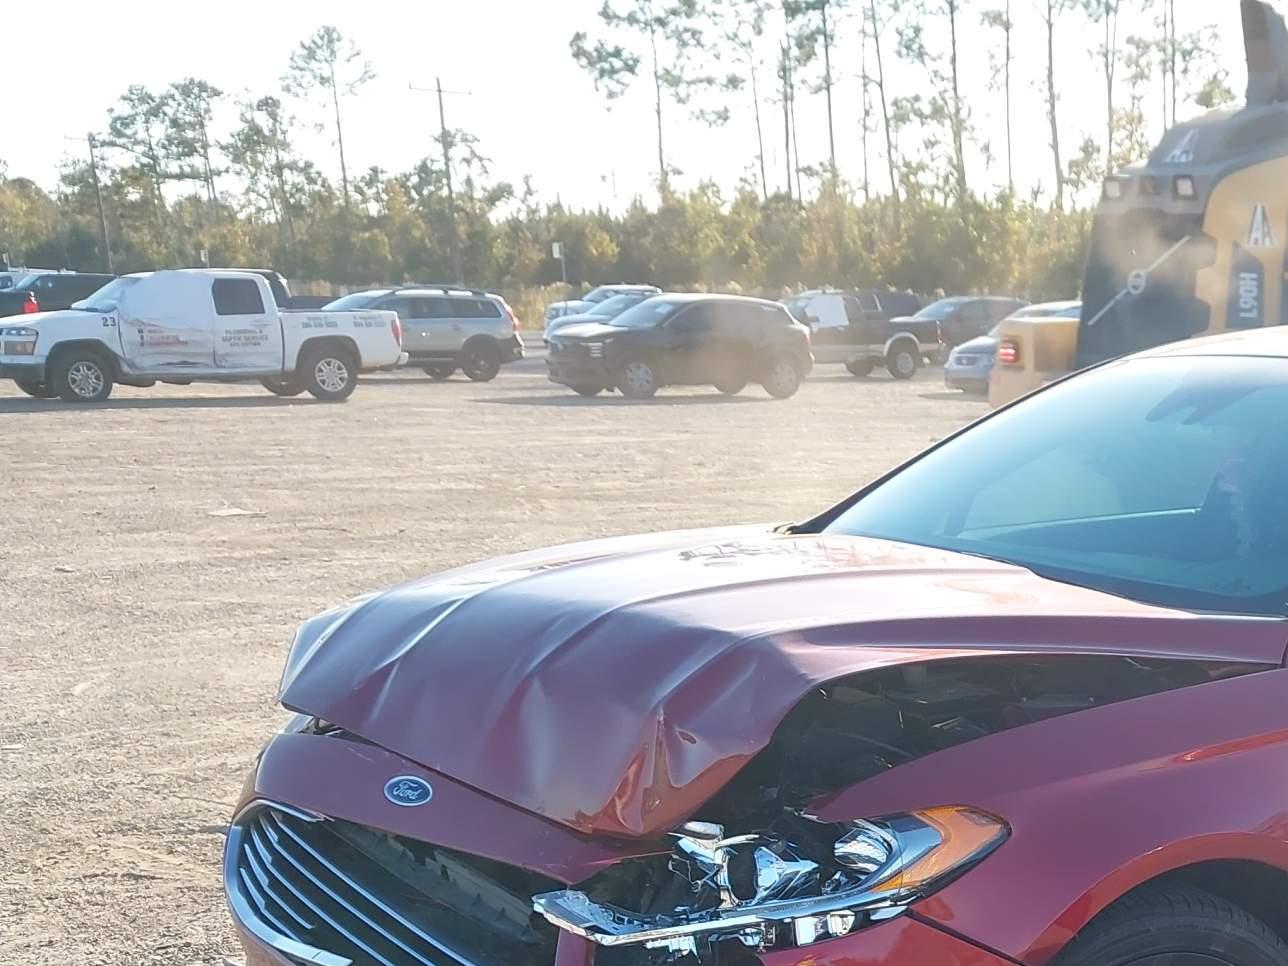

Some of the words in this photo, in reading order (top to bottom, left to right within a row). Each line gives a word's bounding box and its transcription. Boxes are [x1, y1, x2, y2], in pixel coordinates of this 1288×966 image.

[1239, 272, 1258, 318] L90H
[102, 316, 117, 327] 23
[393, 780, 422, 799] Ford
